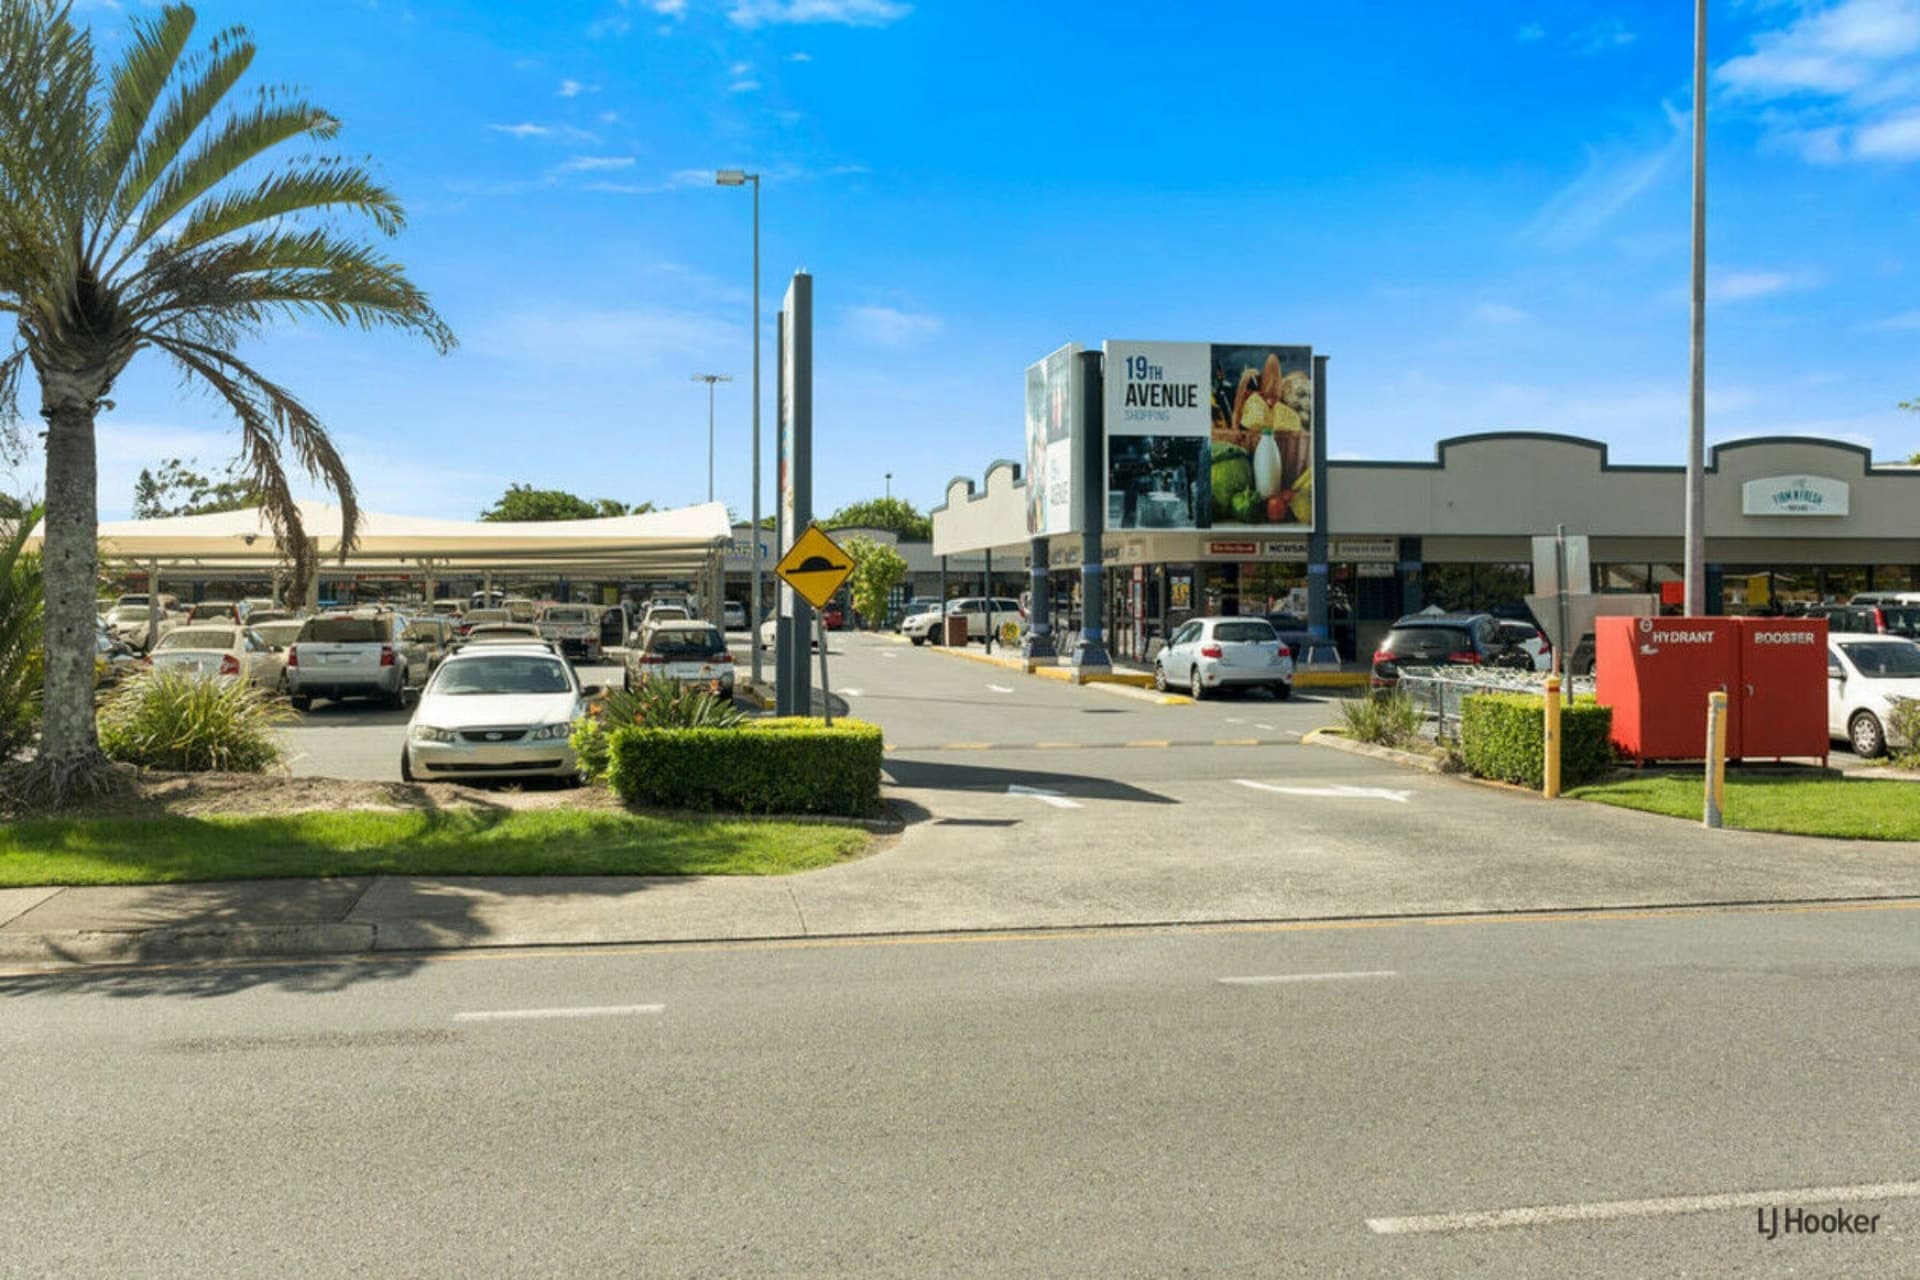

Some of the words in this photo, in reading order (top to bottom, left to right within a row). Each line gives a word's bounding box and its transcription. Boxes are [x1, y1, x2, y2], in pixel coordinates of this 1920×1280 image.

[1126, 355, 1163, 380] 19TH
[1125, 383, 1198, 408] AVENUE
[1125, 409, 1169, 421] SHOPPING
[1653, 631, 1714, 643] HYDRANT
[1754, 632, 1815, 644] BOOSTER
